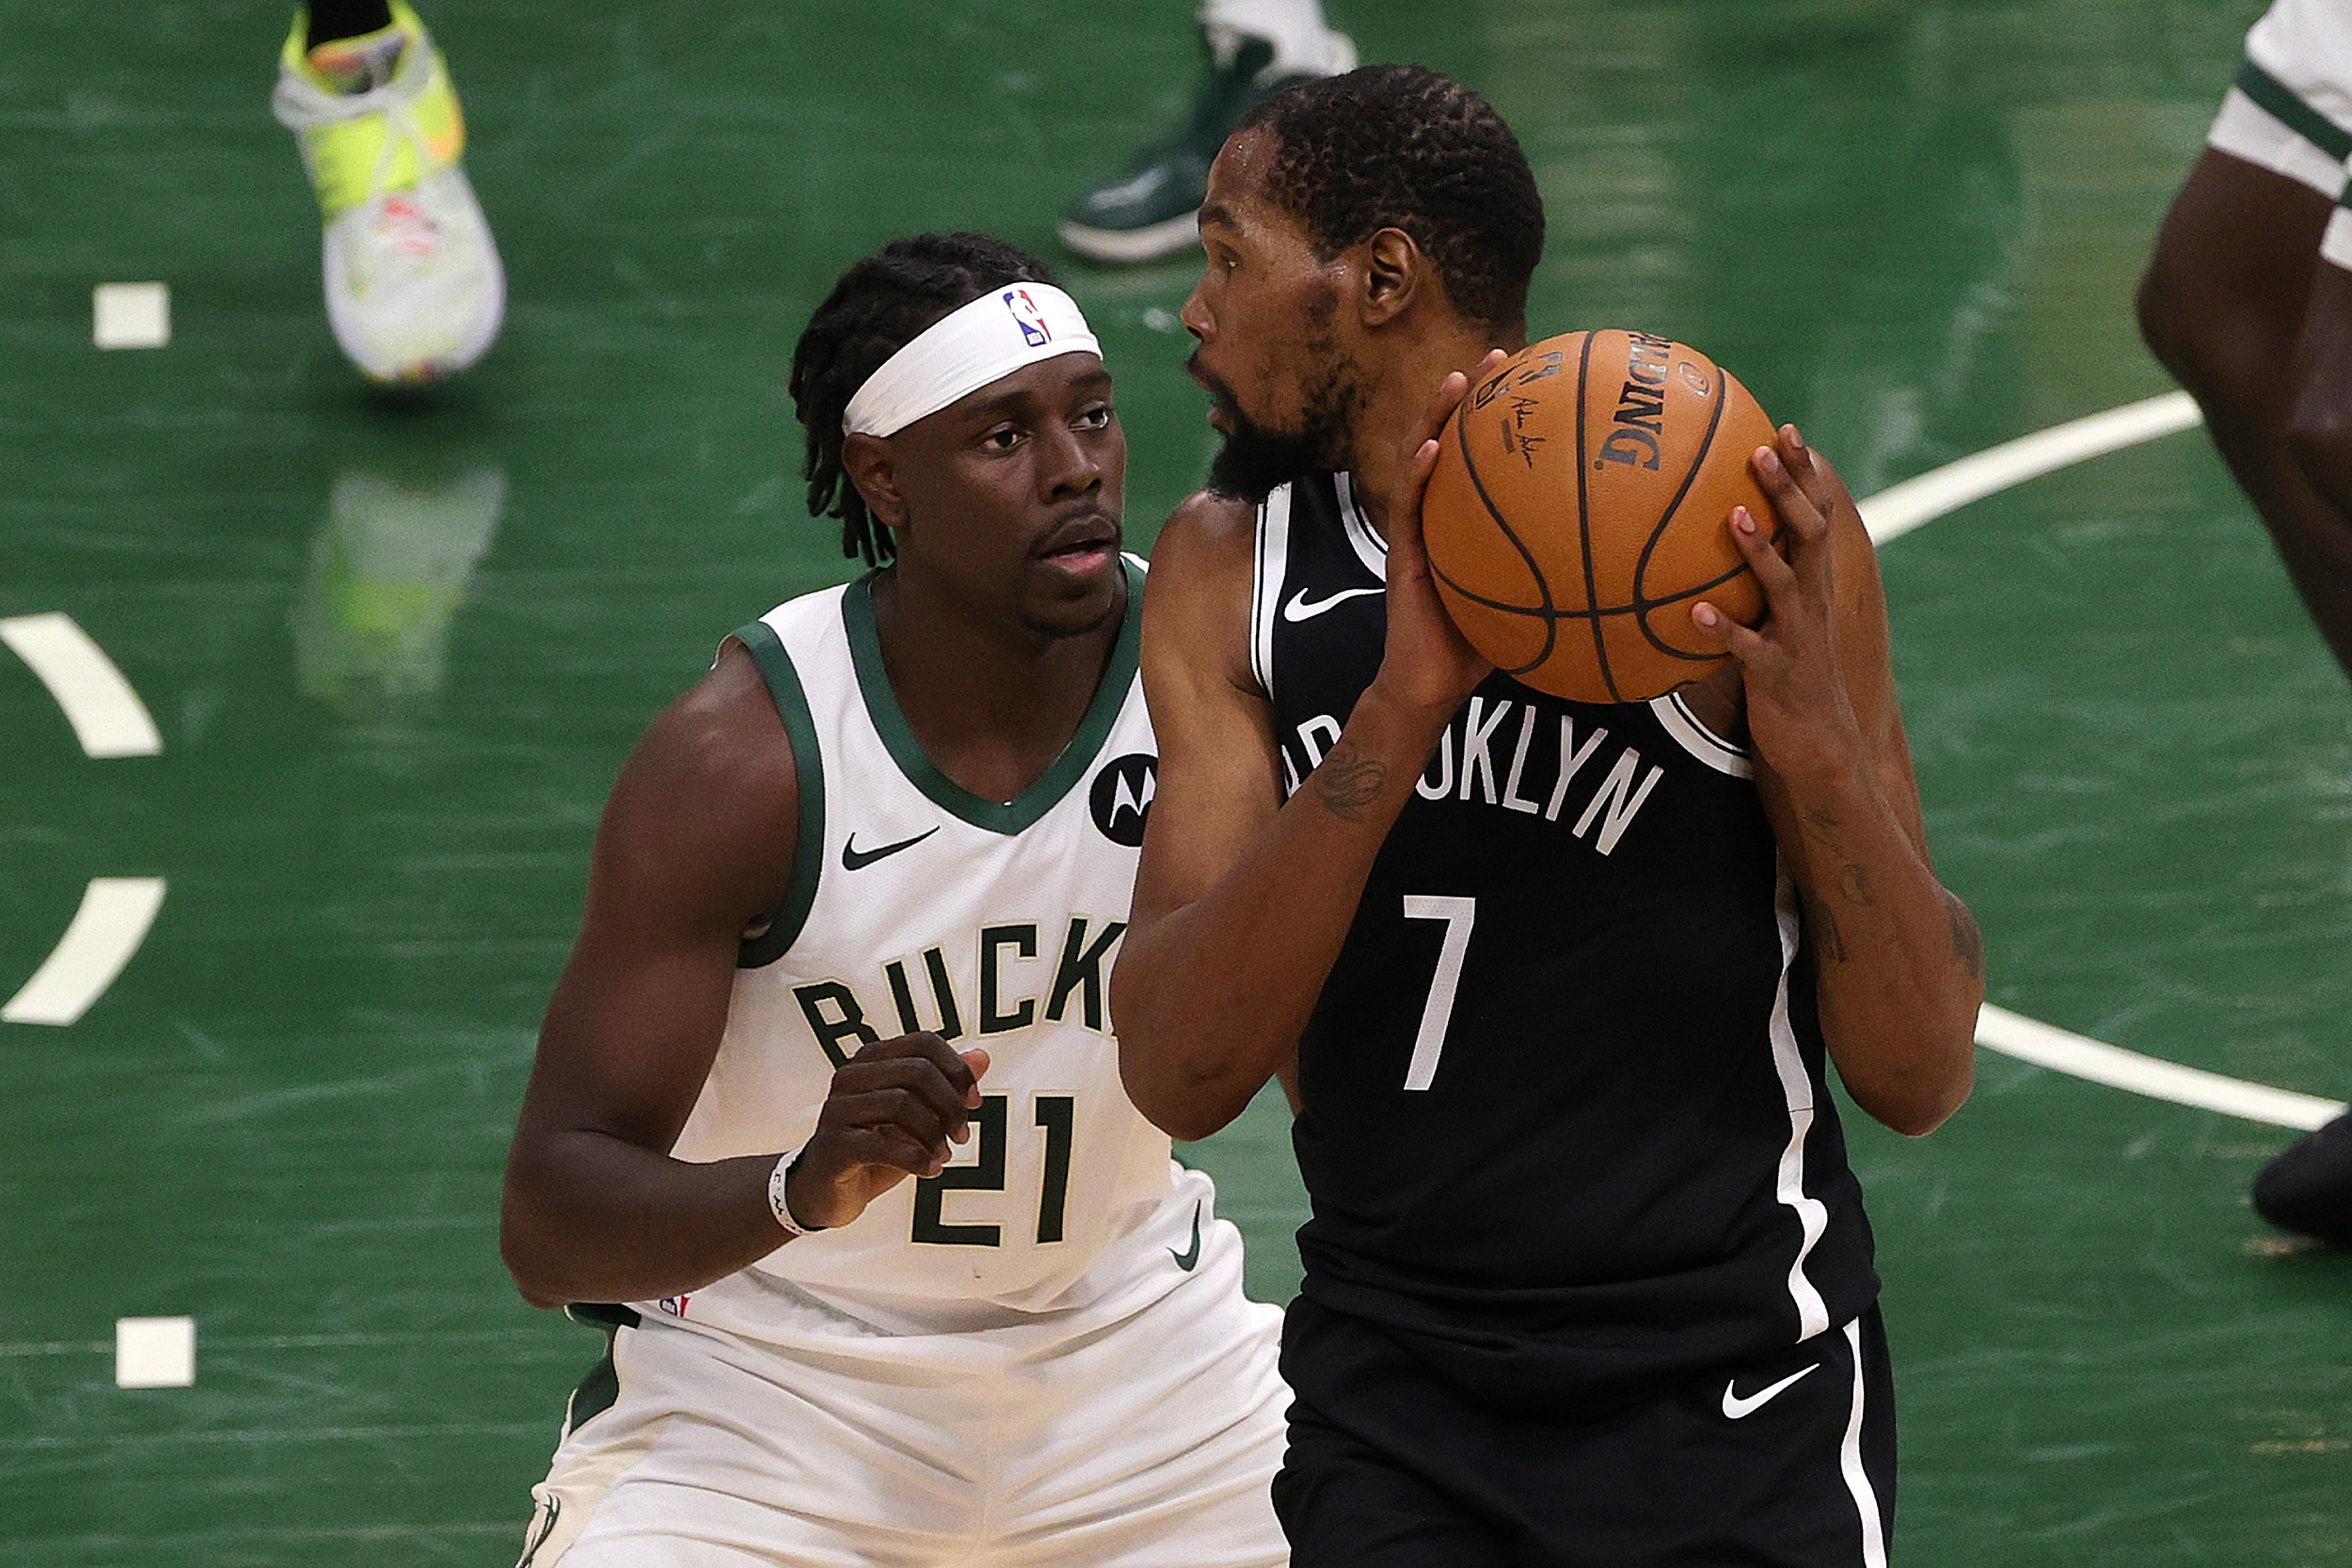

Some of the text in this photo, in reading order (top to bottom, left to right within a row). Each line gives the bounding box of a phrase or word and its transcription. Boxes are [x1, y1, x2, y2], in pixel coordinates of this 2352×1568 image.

[1600, 333, 1674, 471] ALDING
[792, 916, 1128, 1073] BUCK
[1403, 895, 1476, 1091] 7
[911, 1094, 1075, 1248] 21
